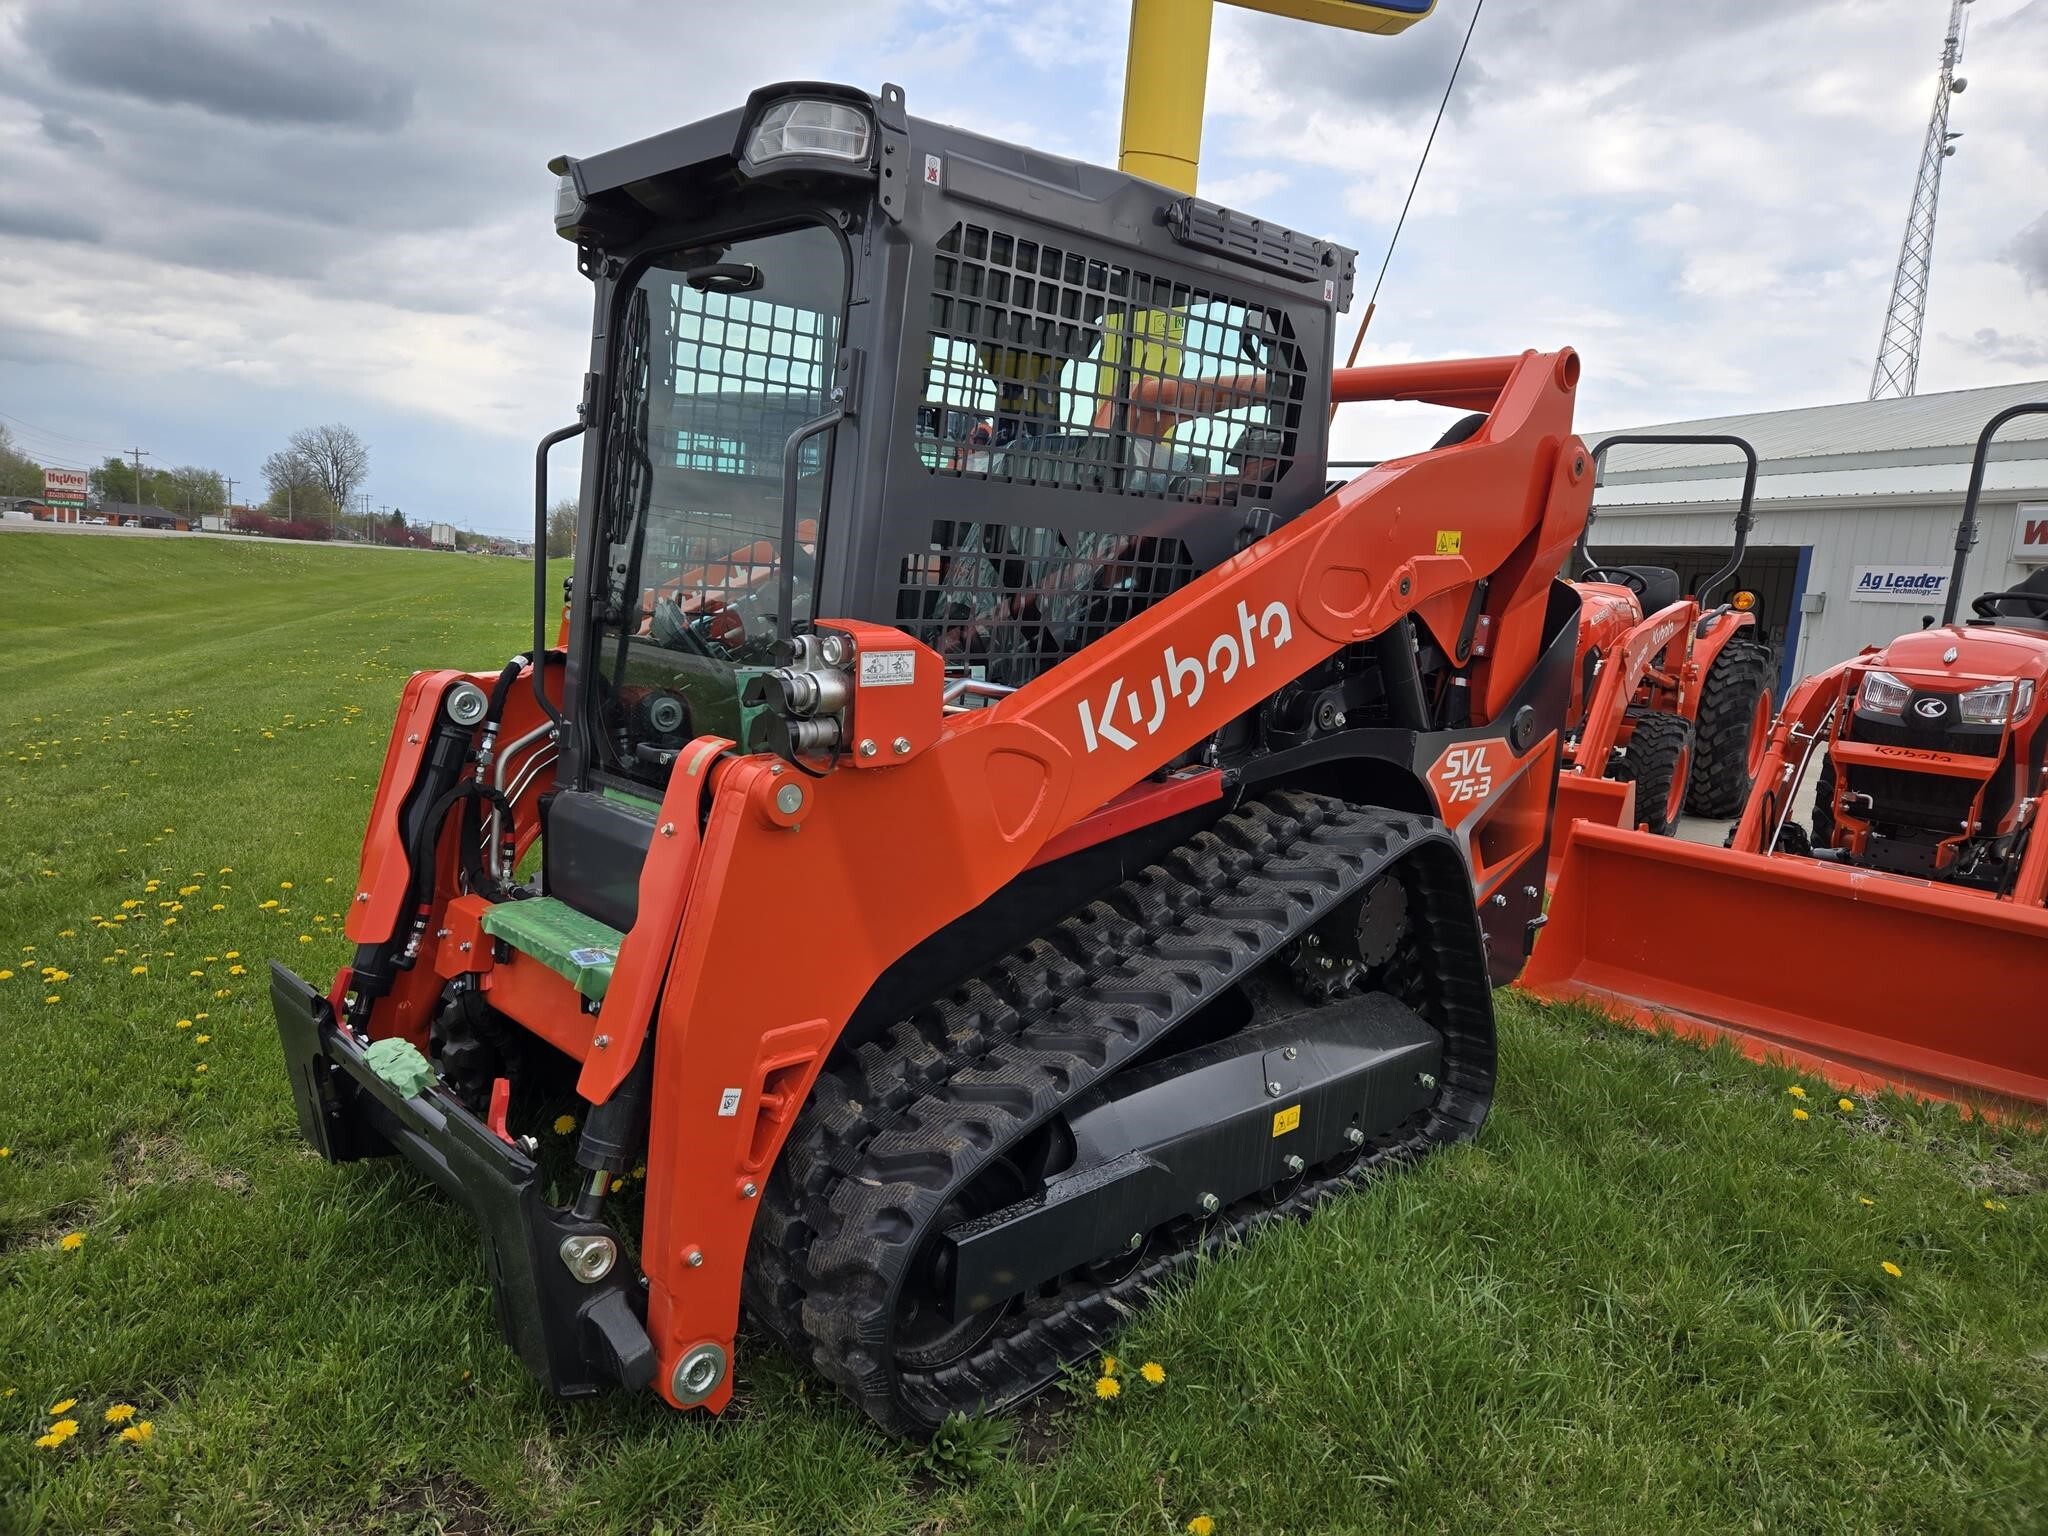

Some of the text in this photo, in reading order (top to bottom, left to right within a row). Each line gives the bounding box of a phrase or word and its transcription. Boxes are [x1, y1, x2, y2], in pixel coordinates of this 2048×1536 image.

[48, 473, 83, 485] HyVee
[1859, 572, 1945, 590] Ag Leader
[1892, 588, 1932, 596] Technology
[1652, 619, 1675, 645] Kubota
[1078, 599, 1293, 754] Kubota
[1441, 746, 1492, 780] SVL
[1875, 746, 1952, 763] Kubota
[1447, 775, 1492, 804] 75-3
